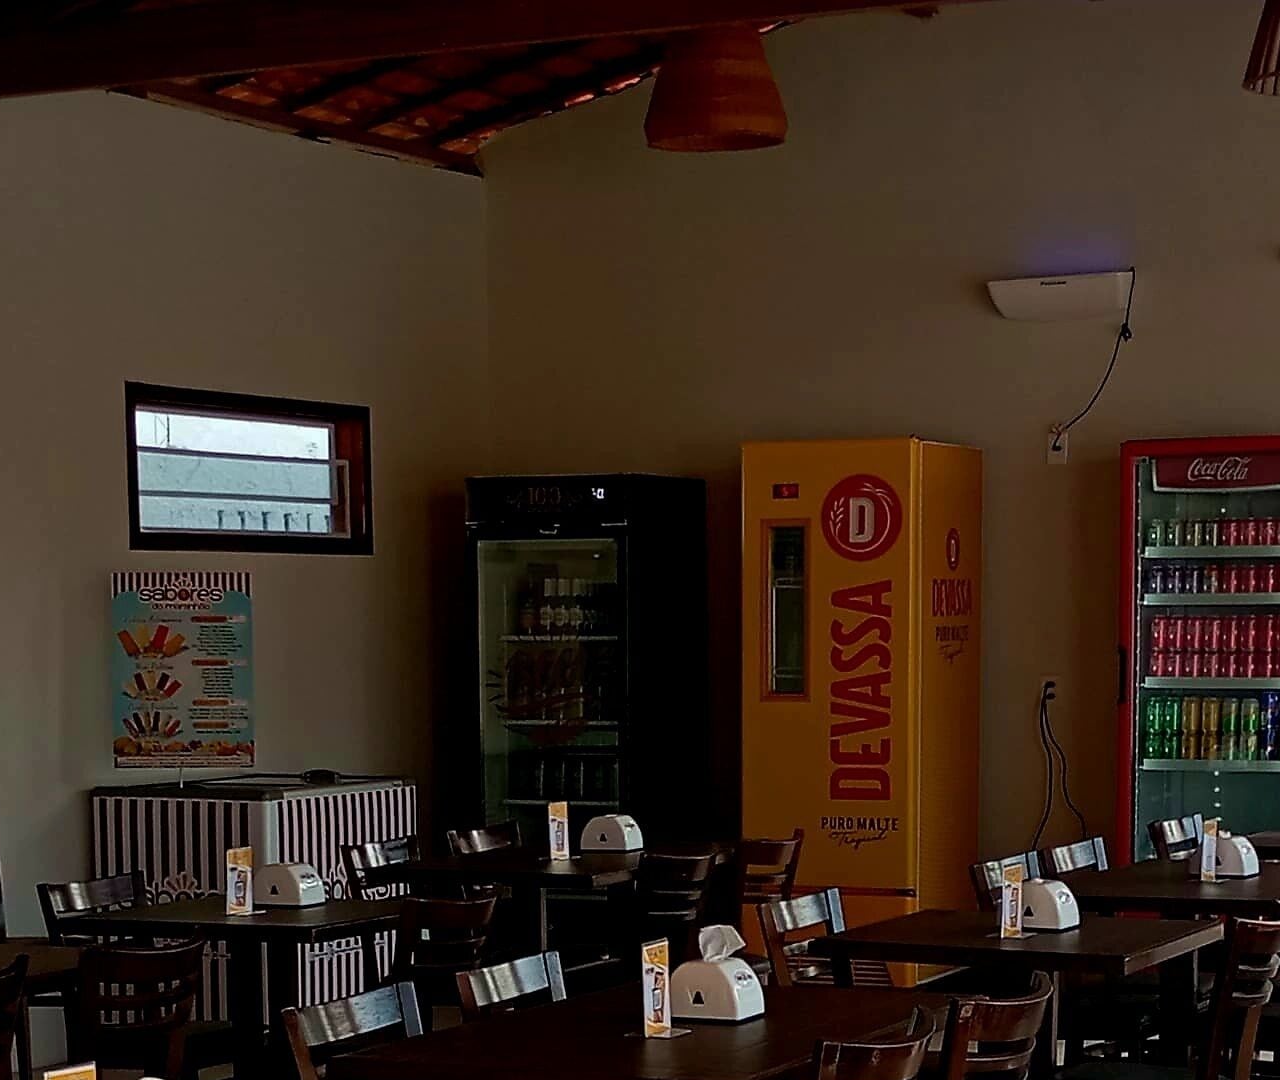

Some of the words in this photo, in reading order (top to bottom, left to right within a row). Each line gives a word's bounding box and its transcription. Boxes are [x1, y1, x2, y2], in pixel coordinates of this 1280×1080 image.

[849, 496, 875, 544] D
[139, 583, 223, 601] sabores
[931, 578, 973, 616] DEVASSA
[830, 579, 892, 800] DEVASSA
[821, 816, 854, 830] PURO
[857, 817, 899, 831] MALTE
